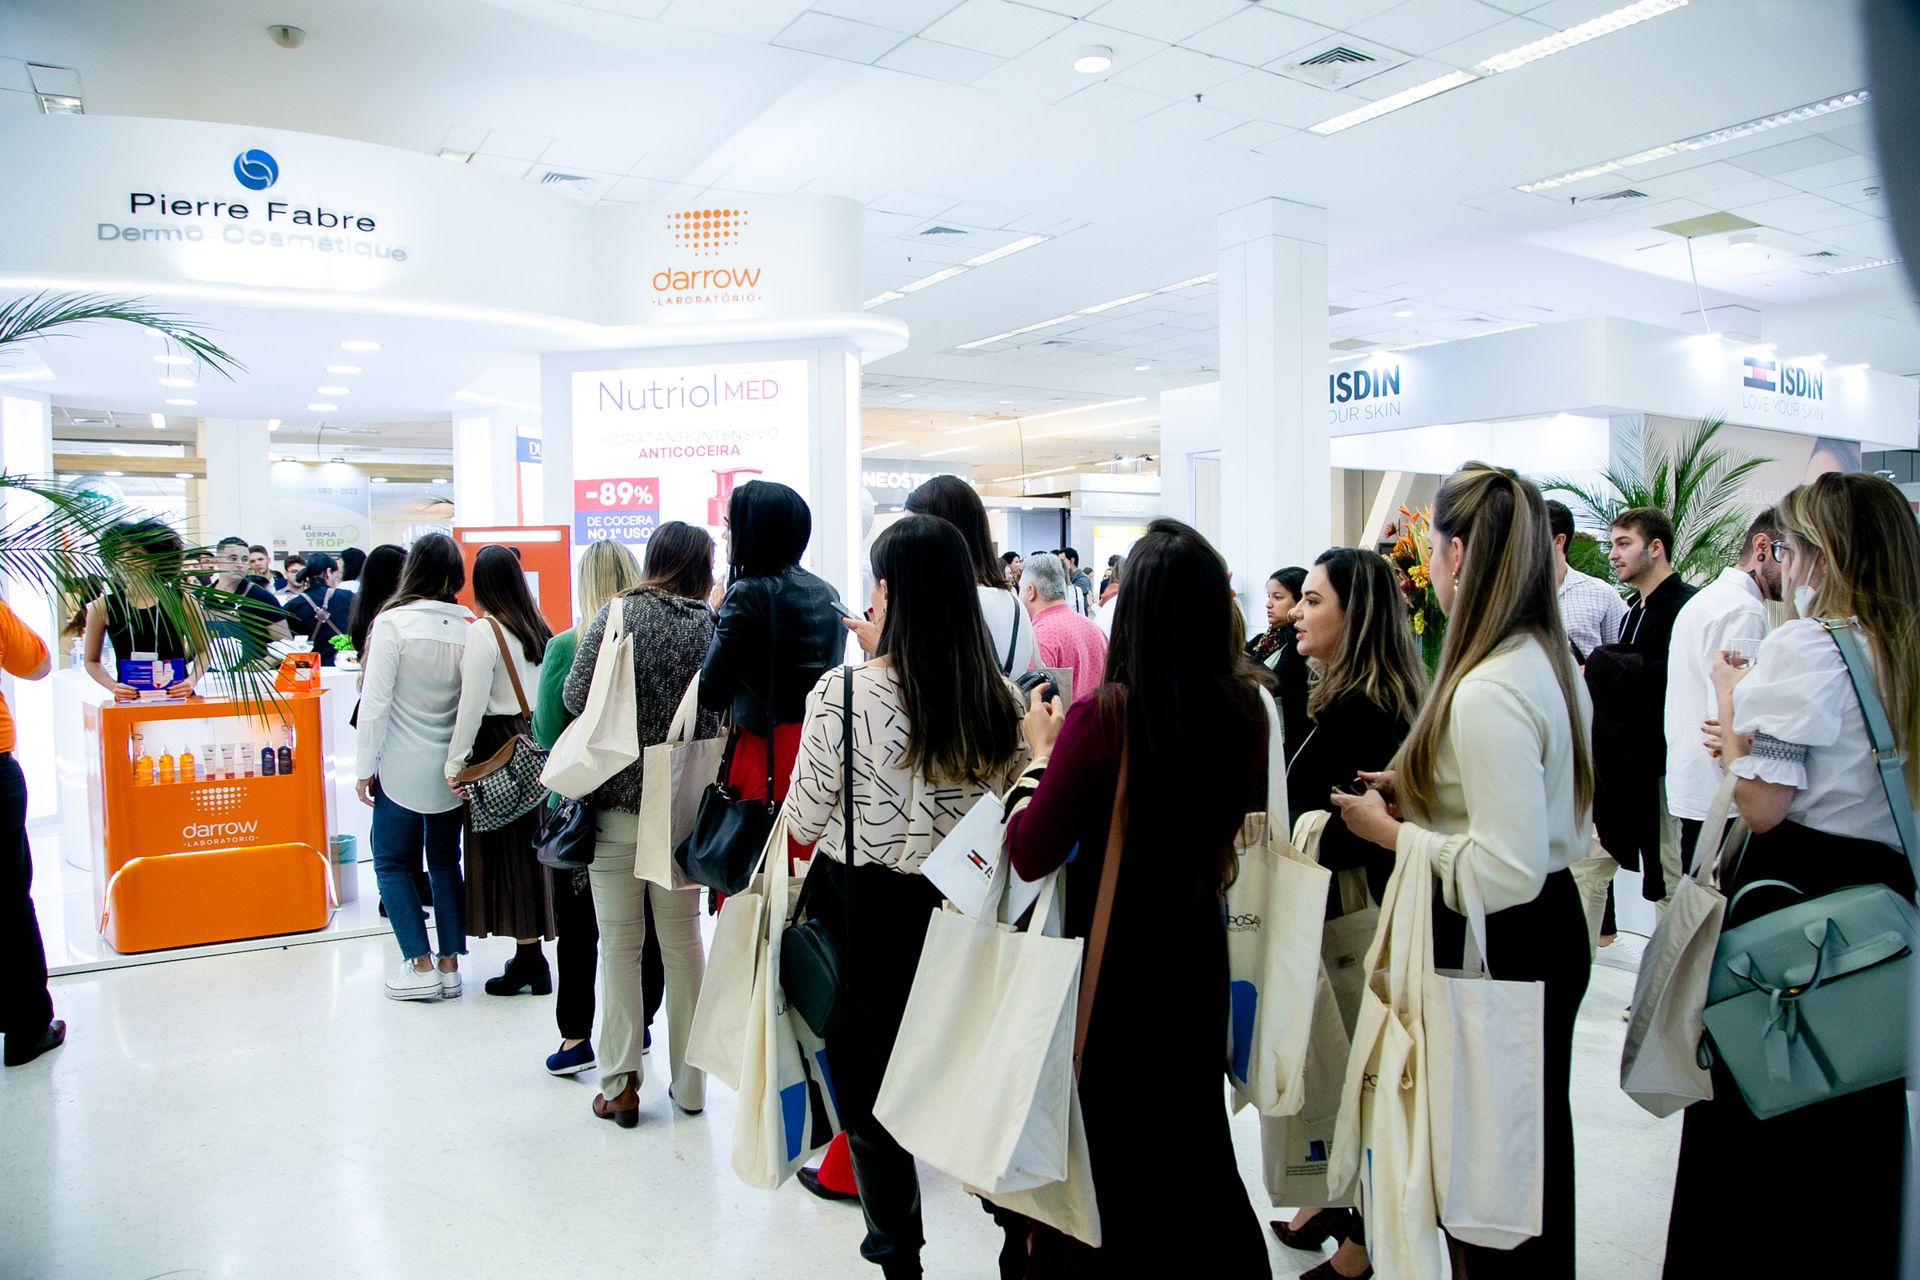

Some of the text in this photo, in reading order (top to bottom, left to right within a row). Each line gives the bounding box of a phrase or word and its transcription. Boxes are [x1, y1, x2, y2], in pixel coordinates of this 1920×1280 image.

[129, 191, 377, 233] Pierre Fabre
[652, 266, 762, 292] darrow
[598, 372, 780, 412] Nutriol MED
[1329, 364, 1400, 404] ISDIN
[1780, 362, 1823, 401] ISDIN
[1328, 401, 1401, 425] OUR SKIN
[1742, 392, 1824, 421] LOVE YOUR SKIN
[600, 426, 780, 447] HIDRATANTE INTENSIVO
[637, 444, 741, 460] ANTICOCEIRA
[584, 481, 654, 507] -89%
[587, 515, 654, 527] DE COCEIRA
[306, 538, 345, 547] TROP
[587, 528, 607, 540] NO
[182, 819, 259, 838] darrow
